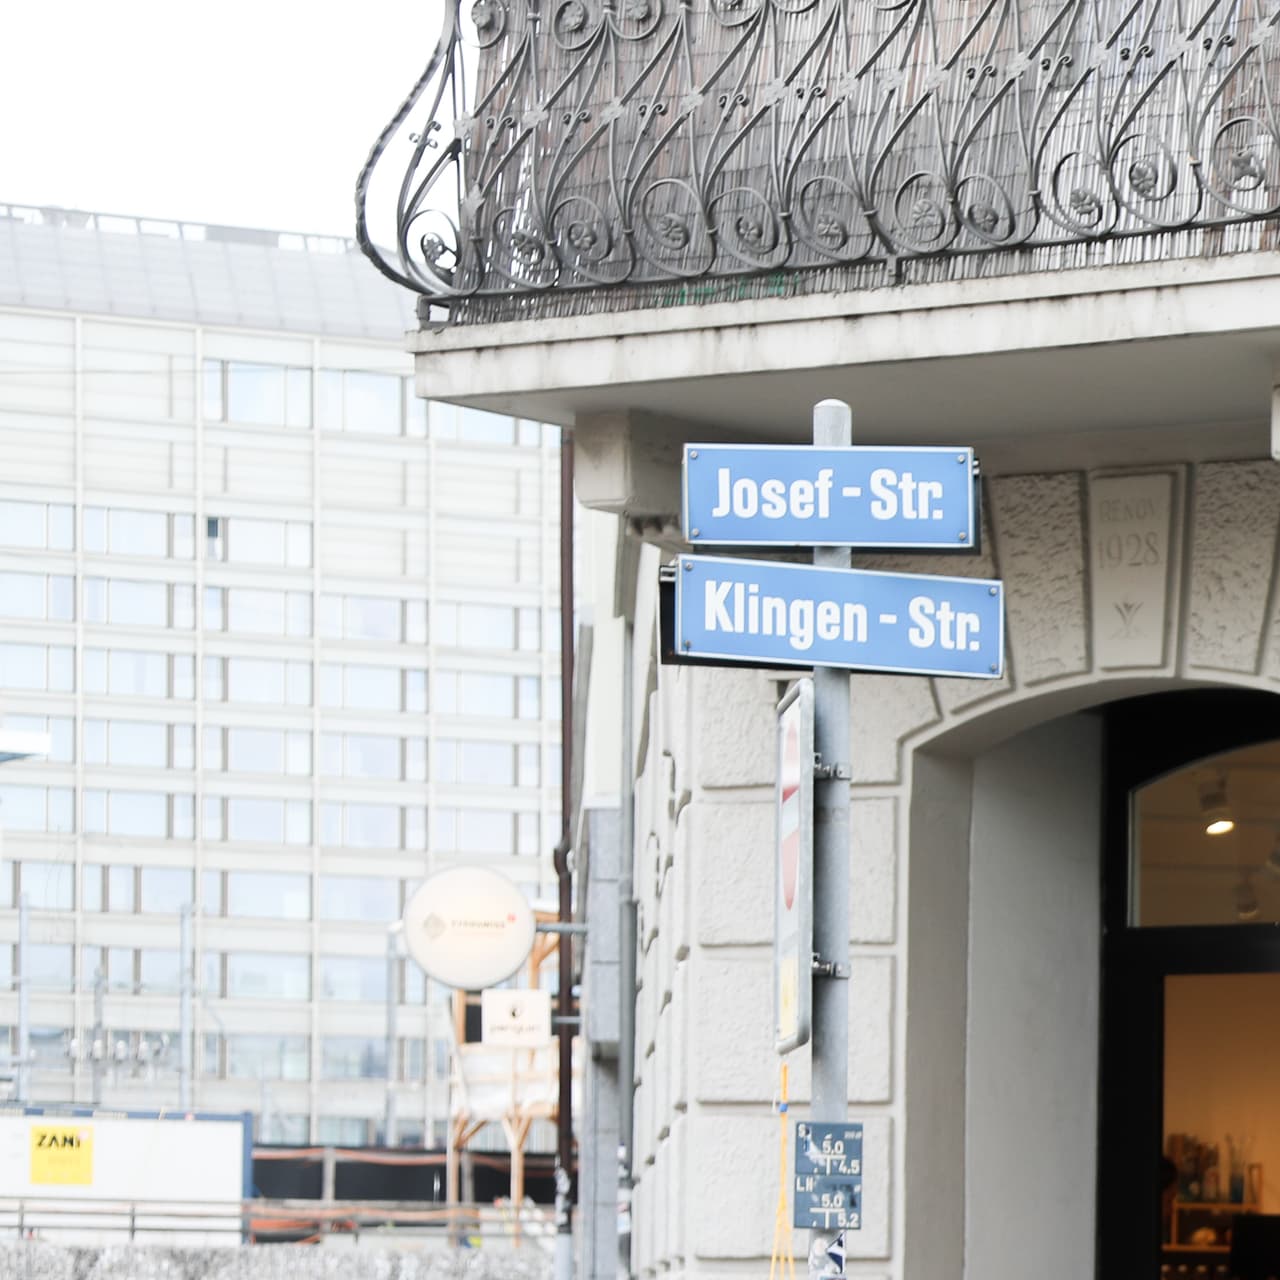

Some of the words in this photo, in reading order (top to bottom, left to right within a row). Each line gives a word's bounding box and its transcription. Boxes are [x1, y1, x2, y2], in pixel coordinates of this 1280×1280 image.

[712, 468, 833, 519] Josef
[869, 468, 944, 520] Str.
[1097, 530, 1160, 569] 1928
[704, 580, 868, 651] Klingen
[908, 596, 981, 652] Str.
